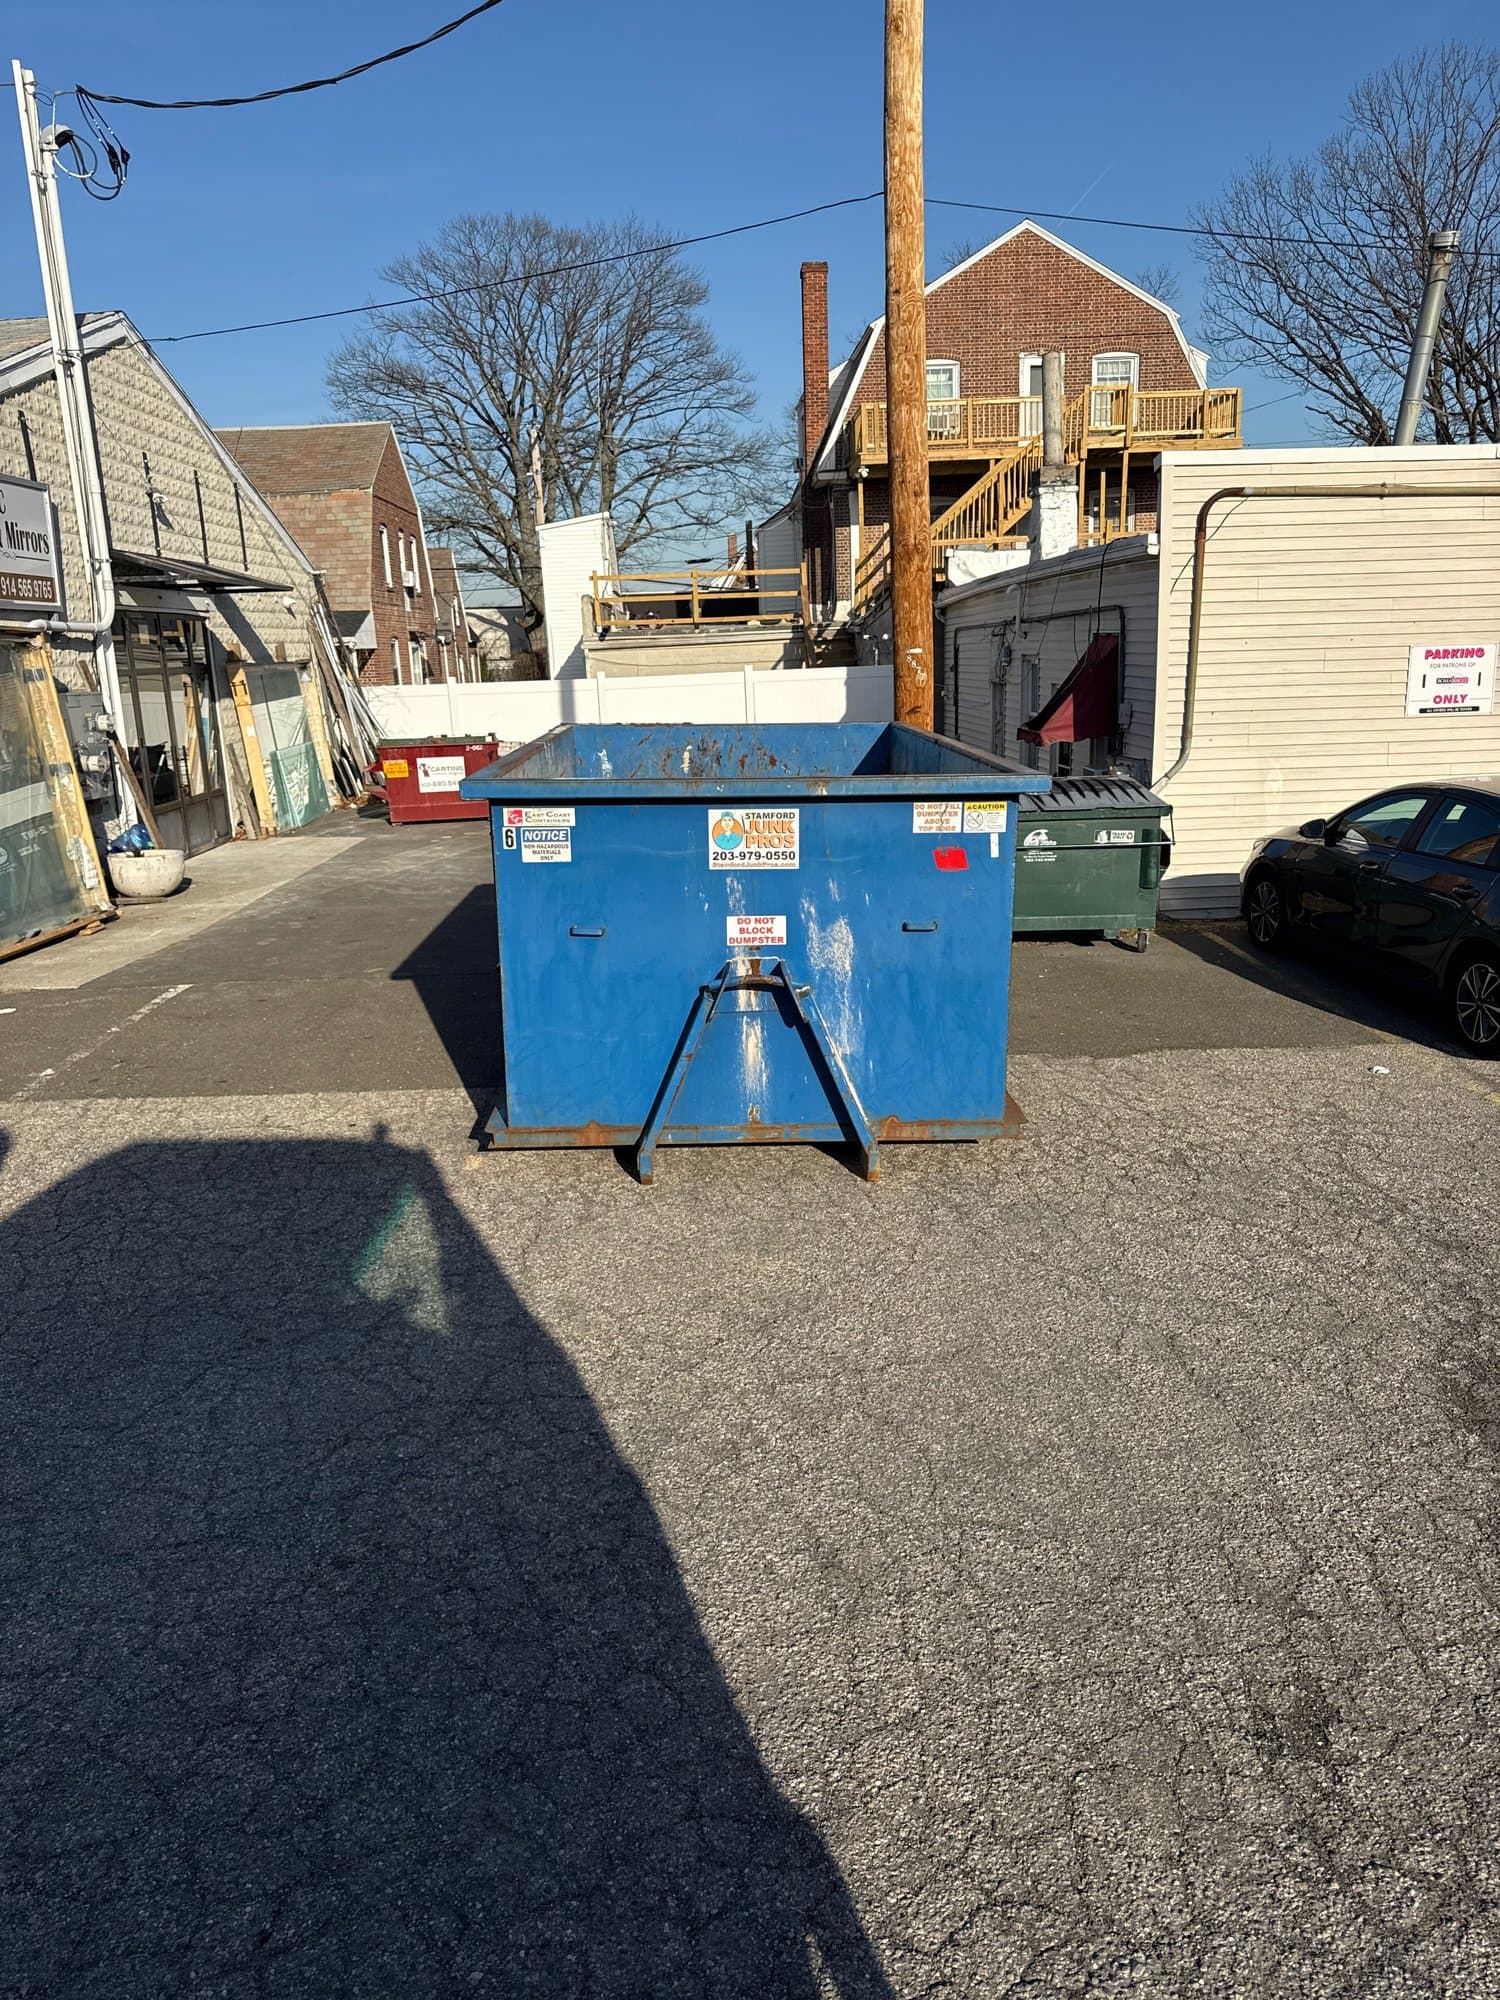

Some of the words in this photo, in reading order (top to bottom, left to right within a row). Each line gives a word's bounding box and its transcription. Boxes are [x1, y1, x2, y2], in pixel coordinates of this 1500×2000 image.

[4, 520, 50, 555] Mirrors
[1, 576, 17, 596] 914
[18, 578, 33, 598] 565
[33, 579, 53, 599] 9765
[1424, 647, 1485, 660] PARKING
[1433, 694, 1468, 704] ONLY
[745, 820, 796, 834] JUNK
[505, 829, 514, 848] 6
[524, 830, 568, 841] NOTICE
[745, 834, 796, 849] PROS
[712, 851, 796, 861] 203-979-0550
[737, 917, 752, 925] DO
[754, 917, 776, 925] NOT
[728, 936, 785, 944] DUMPSTER
